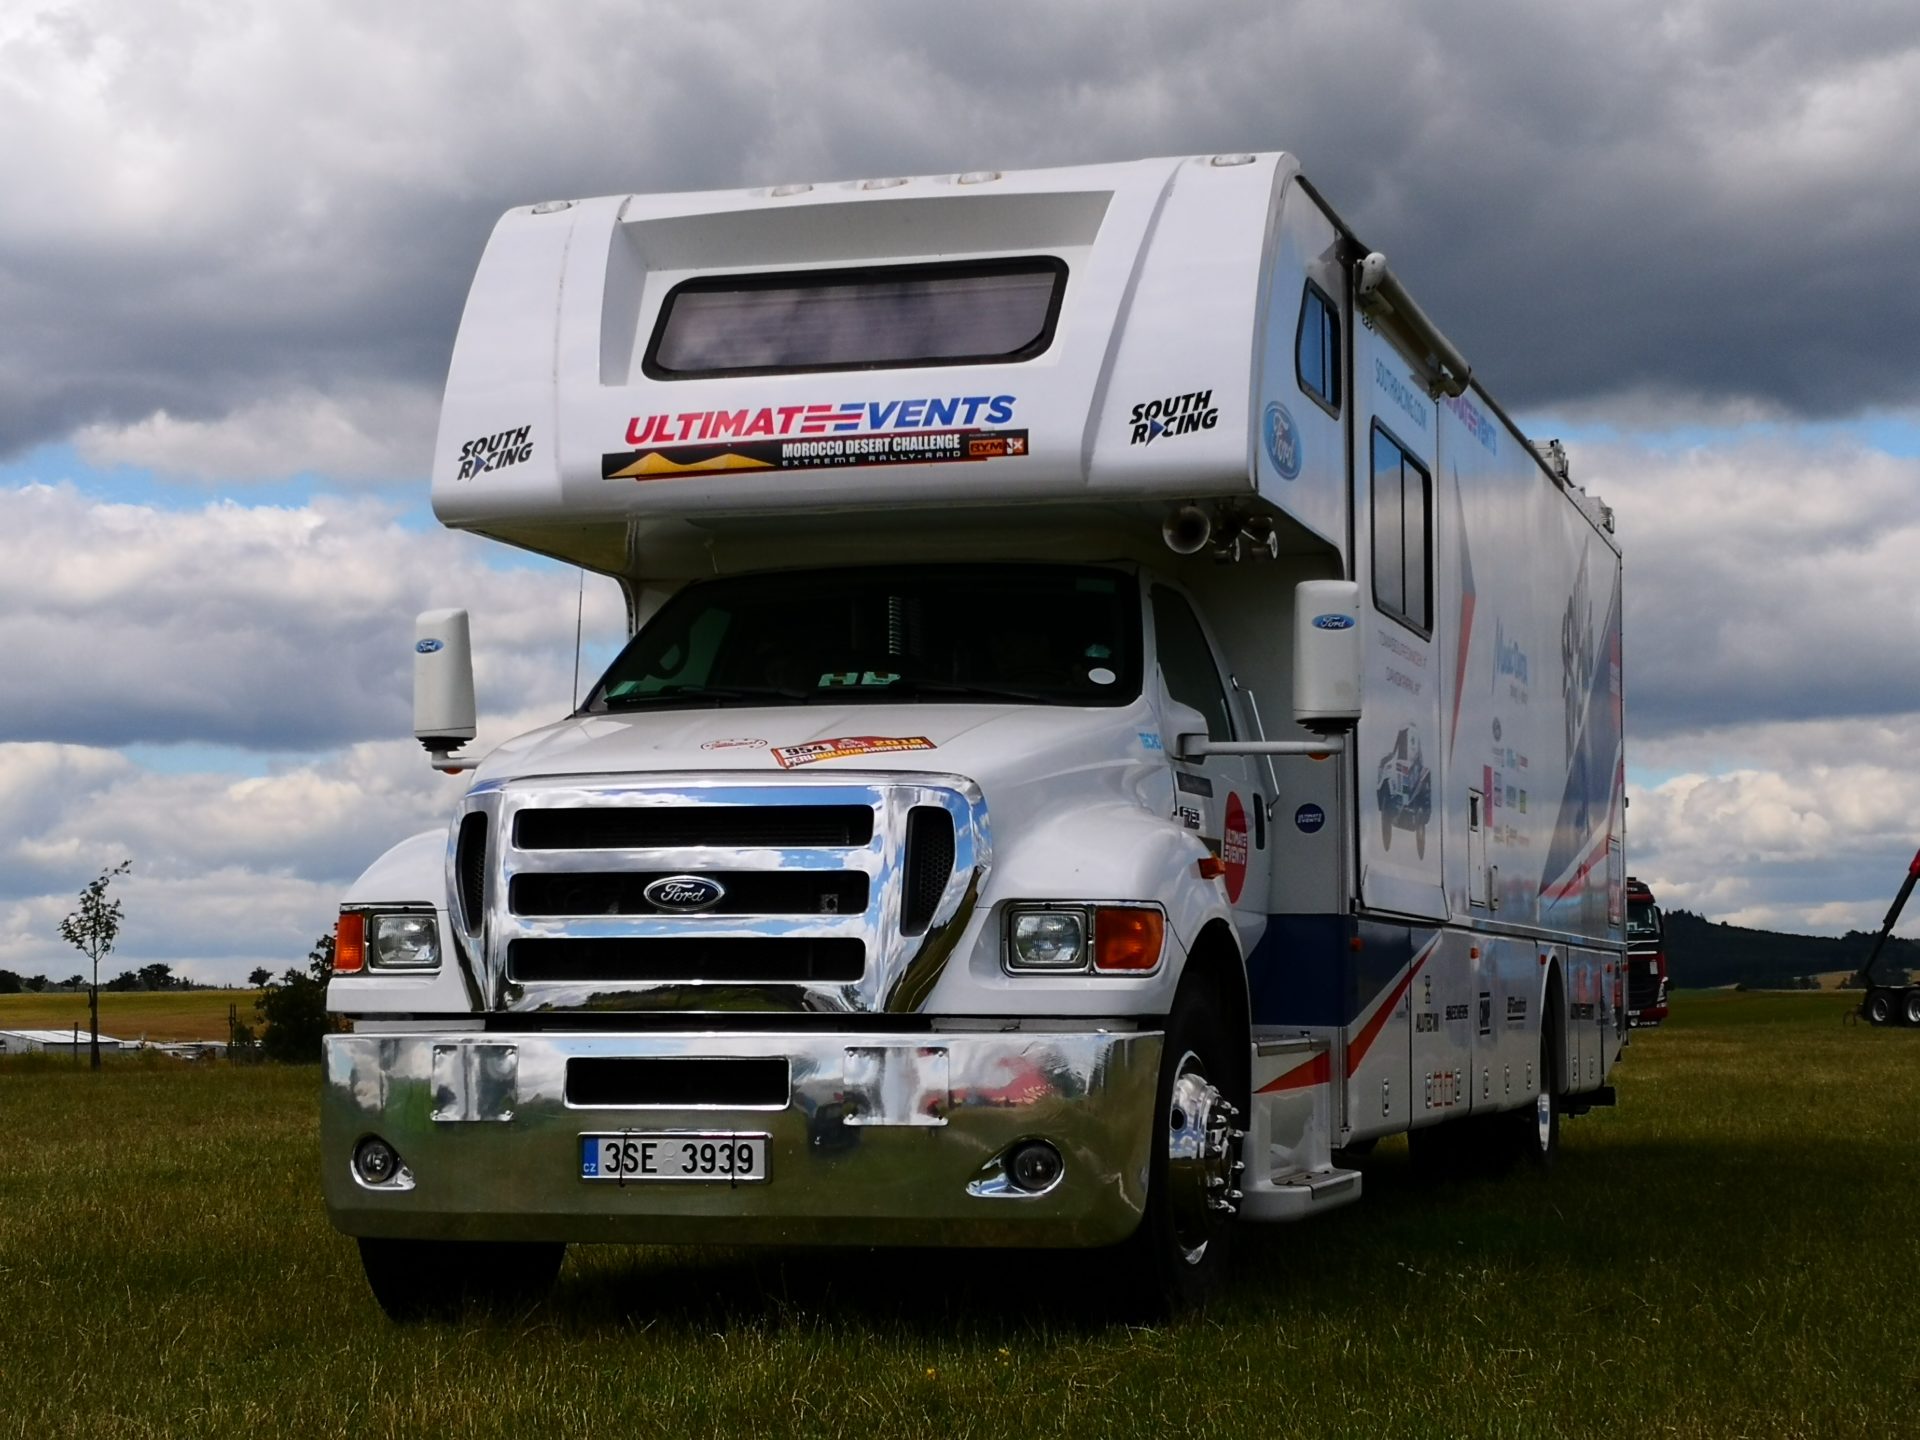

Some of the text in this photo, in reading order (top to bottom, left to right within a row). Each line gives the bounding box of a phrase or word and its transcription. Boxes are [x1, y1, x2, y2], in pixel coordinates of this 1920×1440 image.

[1128, 389, 1213, 424] SOUTH
[625, 395, 1017, 445] ULTIMATE EVENTS
[458, 424, 532, 462] SOUTH
[782, 440, 844, 458] MOROCCO
[846, 436, 891, 455] DESERT
[892, 433, 961, 452] CHALLENGE
[782, 456, 857, 466] EXTREME
[1320, 616, 1346, 628] Ford
[785, 744, 827, 757] 954
[873, 738, 923, 747] 2018
[784, 743, 930, 767] PERU BOLIVIA ARGENTINA
[1224, 844, 1246, 865] EVENTS
[660, 883, 706, 902] Ford
[583, 1163, 597, 1173] CZ
[605, 1143, 753, 1174] 3SE 3939
